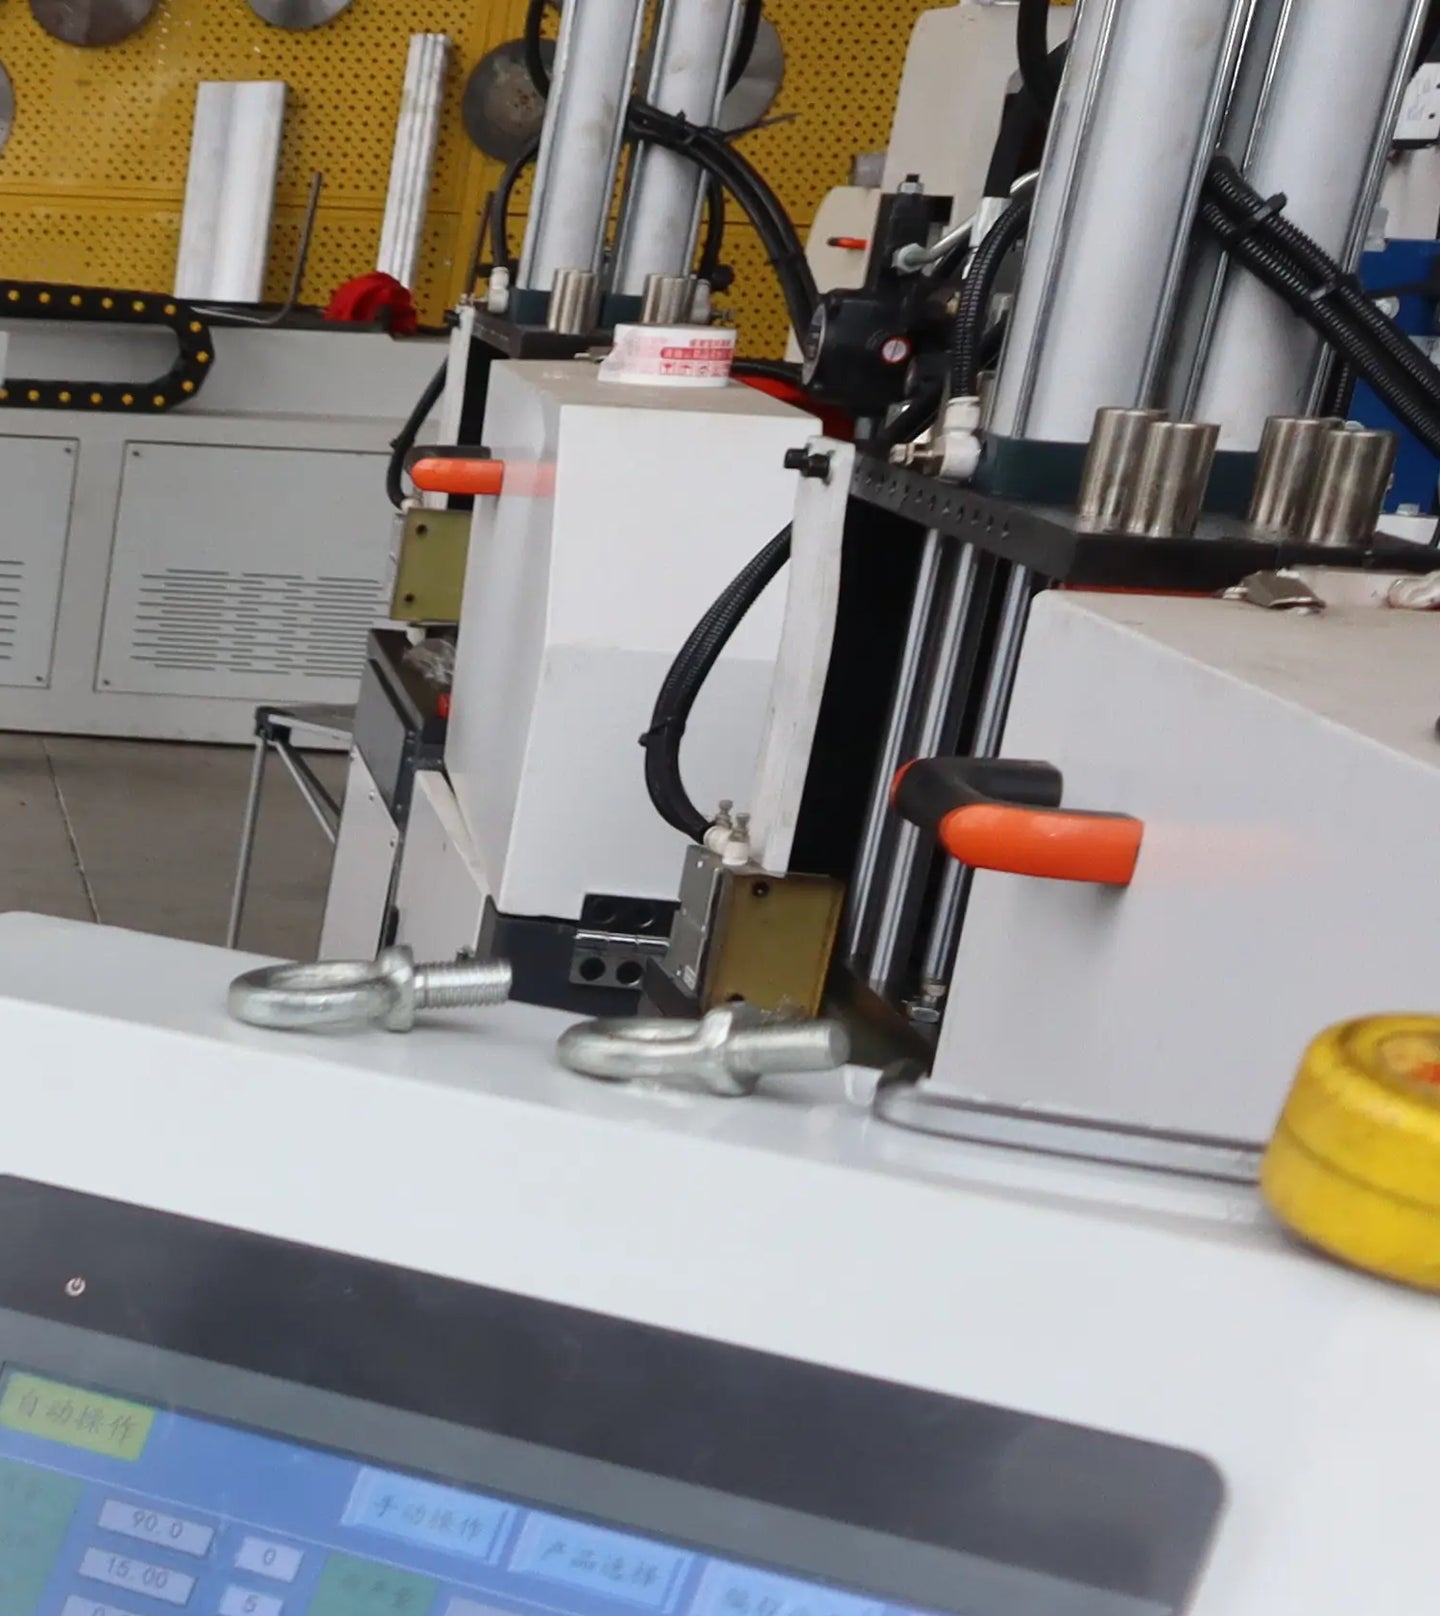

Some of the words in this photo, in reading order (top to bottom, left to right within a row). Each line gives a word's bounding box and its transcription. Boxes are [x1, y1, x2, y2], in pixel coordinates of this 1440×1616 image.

[16, 1388, 139, 1447] 自动操作
[133, 1509, 184, 1539] 90.0
[263, 1548, 277, 1567] 0
